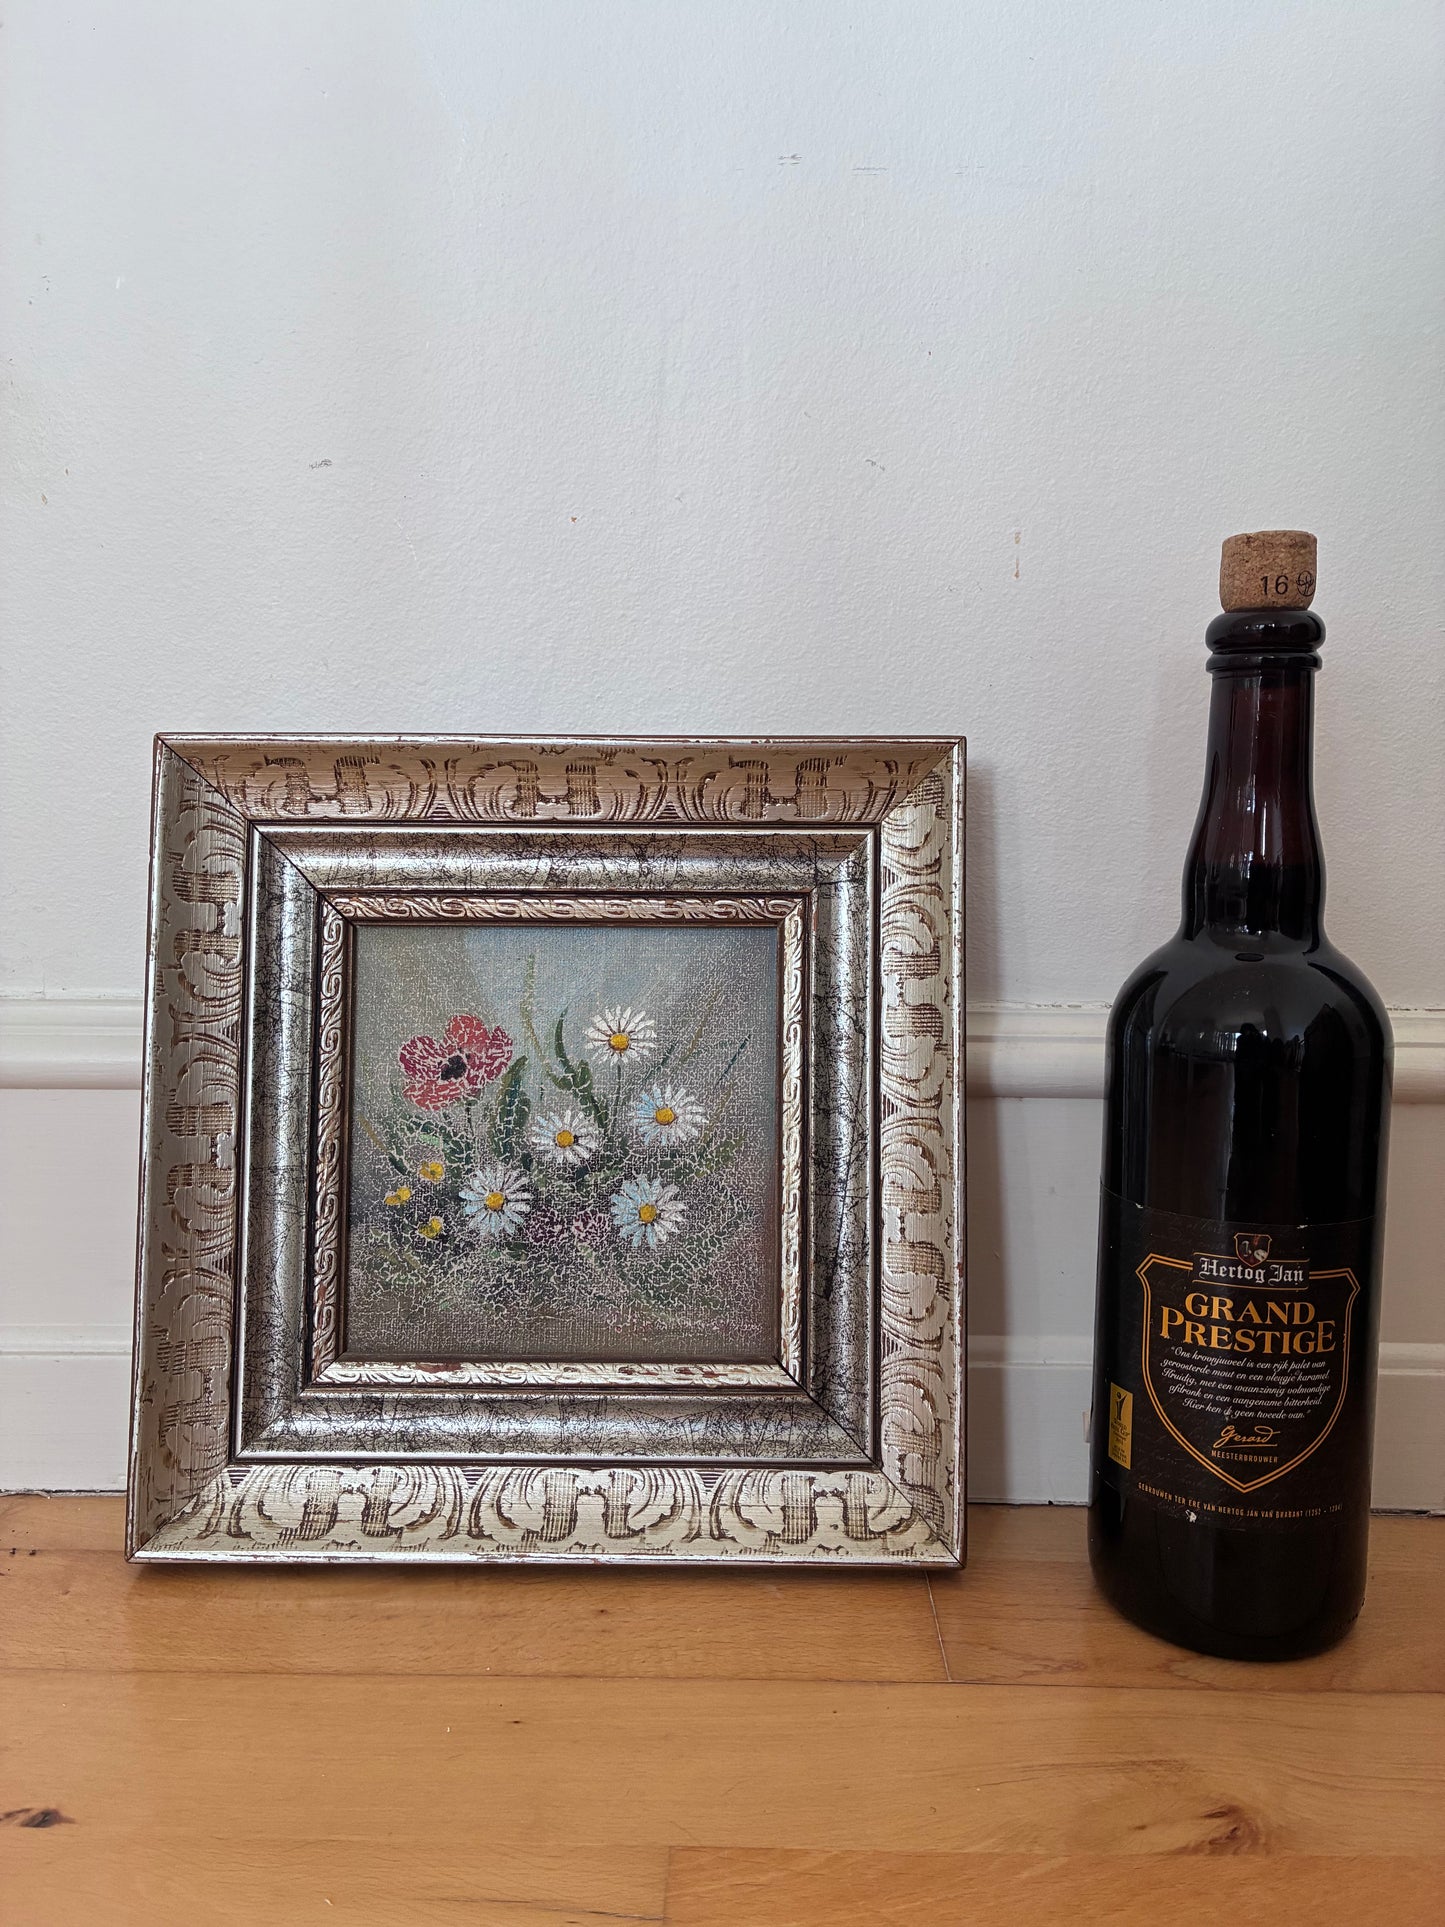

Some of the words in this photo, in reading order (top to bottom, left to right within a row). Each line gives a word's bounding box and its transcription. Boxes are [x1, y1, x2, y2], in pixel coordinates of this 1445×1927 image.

[1260, 574, 1289, 596] 16
[1199, 1257, 1266, 1284] Hertog
[1267, 1264, 1304, 1286] Jan
[1184, 1292, 1316, 1325] GRAND
[1159, 1305, 1337, 1355] PRESTIGE
[1160, 1358, 1211, 1375] geroosterde
[1211, 1369, 1235, 1378] mout
[1287, 1359, 1311, 1373] palet
[1311, 1361, 1326, 1369] van
[1199, 1379, 1217, 1388] met
[1217, 1383, 1232, 1391] een
[1203, 1392, 1214, 1400] en
[1215, 1394, 1231, 1403] een
[1211, 1450, 1278, 1464] MEESTERBROUWER
